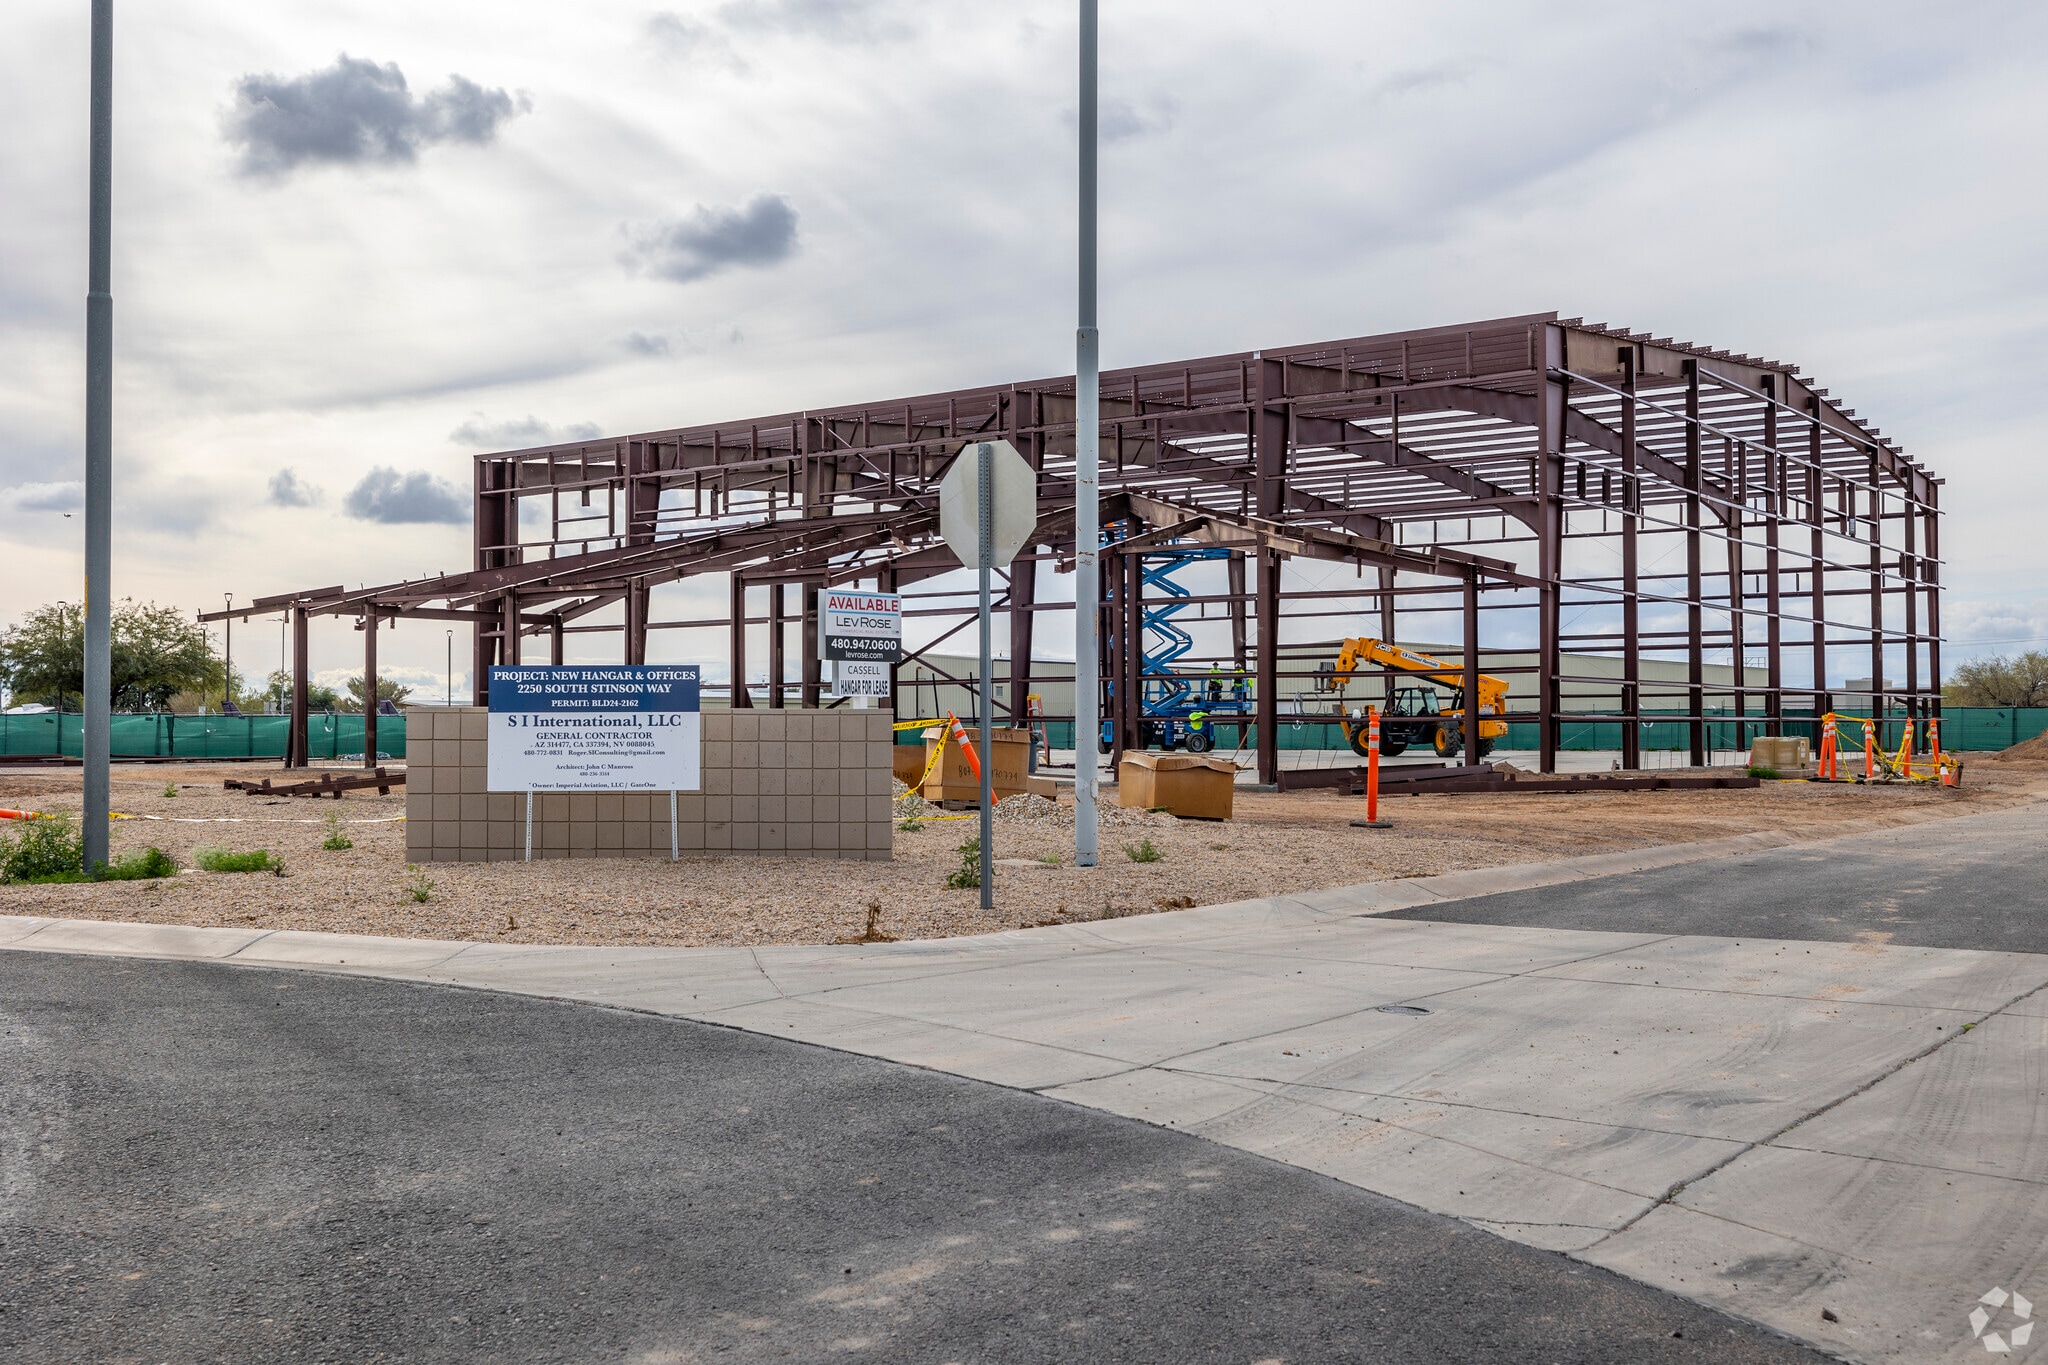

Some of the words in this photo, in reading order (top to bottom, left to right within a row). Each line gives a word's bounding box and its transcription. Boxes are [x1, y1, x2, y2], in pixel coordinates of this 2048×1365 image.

[829, 596, 898, 612] AVAILABLE
[831, 639, 896, 650] 480.947.0600
[1375, 644, 1391, 652] JCB
[1422, 658, 1438, 667] Rentals
[848, 666, 880, 674] CASSELL
[494, 672, 549, 681] PROJECT:
[552, 672, 579, 680] NEW
[582, 672, 633, 680] HANGAR
[635, 672, 644, 680] &
[646, 671, 696, 680] OFFICES
[517, 684, 542, 694] 2250
[545, 684, 588, 693] SOUTH
[591, 684, 644, 693] STINSON
[646, 684, 672, 693] WAY
[841, 680, 860, 694] HANGAR
[863, 680, 872, 694] FOR
[873, 681, 888, 695] LEASE
[508, 715, 517, 727] S
[522, 716, 528, 726] I
[533, 715, 642, 729] International,
[648, 714, 681, 726] LLC
